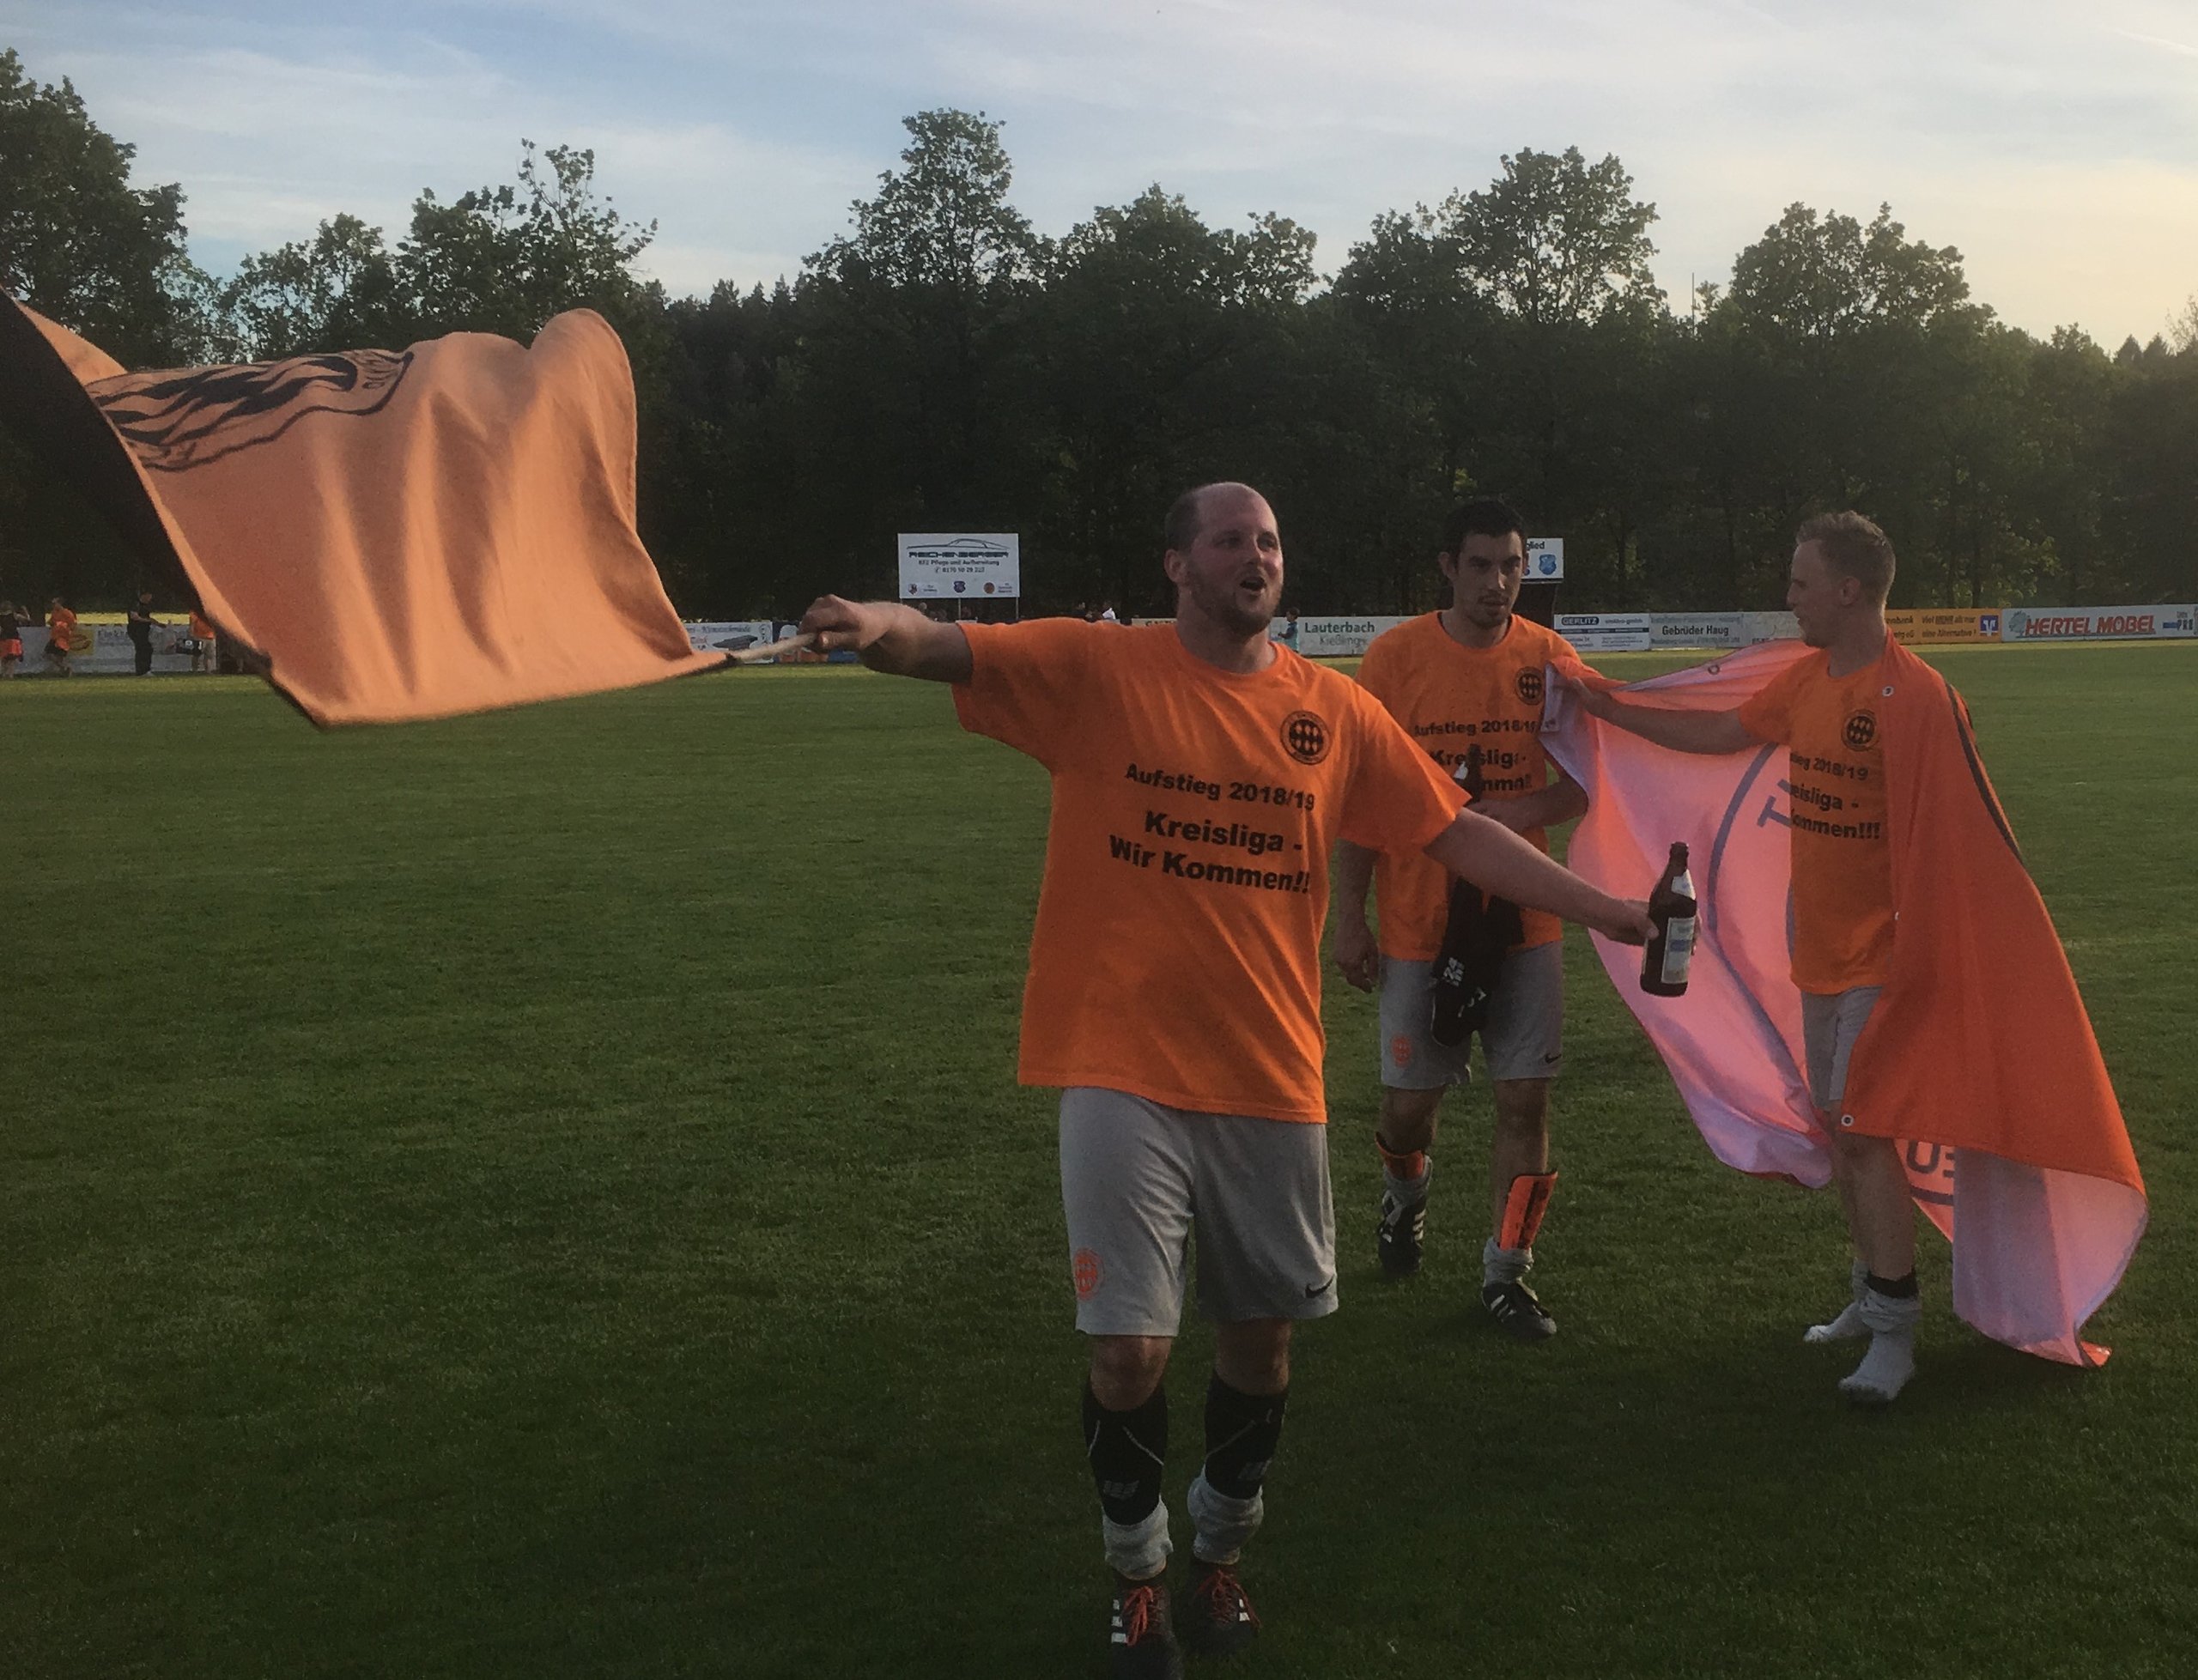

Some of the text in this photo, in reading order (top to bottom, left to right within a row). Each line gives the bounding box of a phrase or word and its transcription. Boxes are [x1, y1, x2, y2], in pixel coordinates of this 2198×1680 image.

[1304, 621, 1375, 634] Lauterbach
[1562, 616, 1598, 625] GERLITZ
[1661, 624, 1729, 636] Gebrüder Haug
[2025, 616, 2092, 636] HERTEL
[1813, 757, 1869, 781] 2018/19
[1125, 762, 1315, 812] Aufstieg 2018/19
[1145, 810, 1284, 856] Kreisliga
[1790, 810, 1882, 840] ommen!!!
[1108, 834, 1157, 868] Wir
